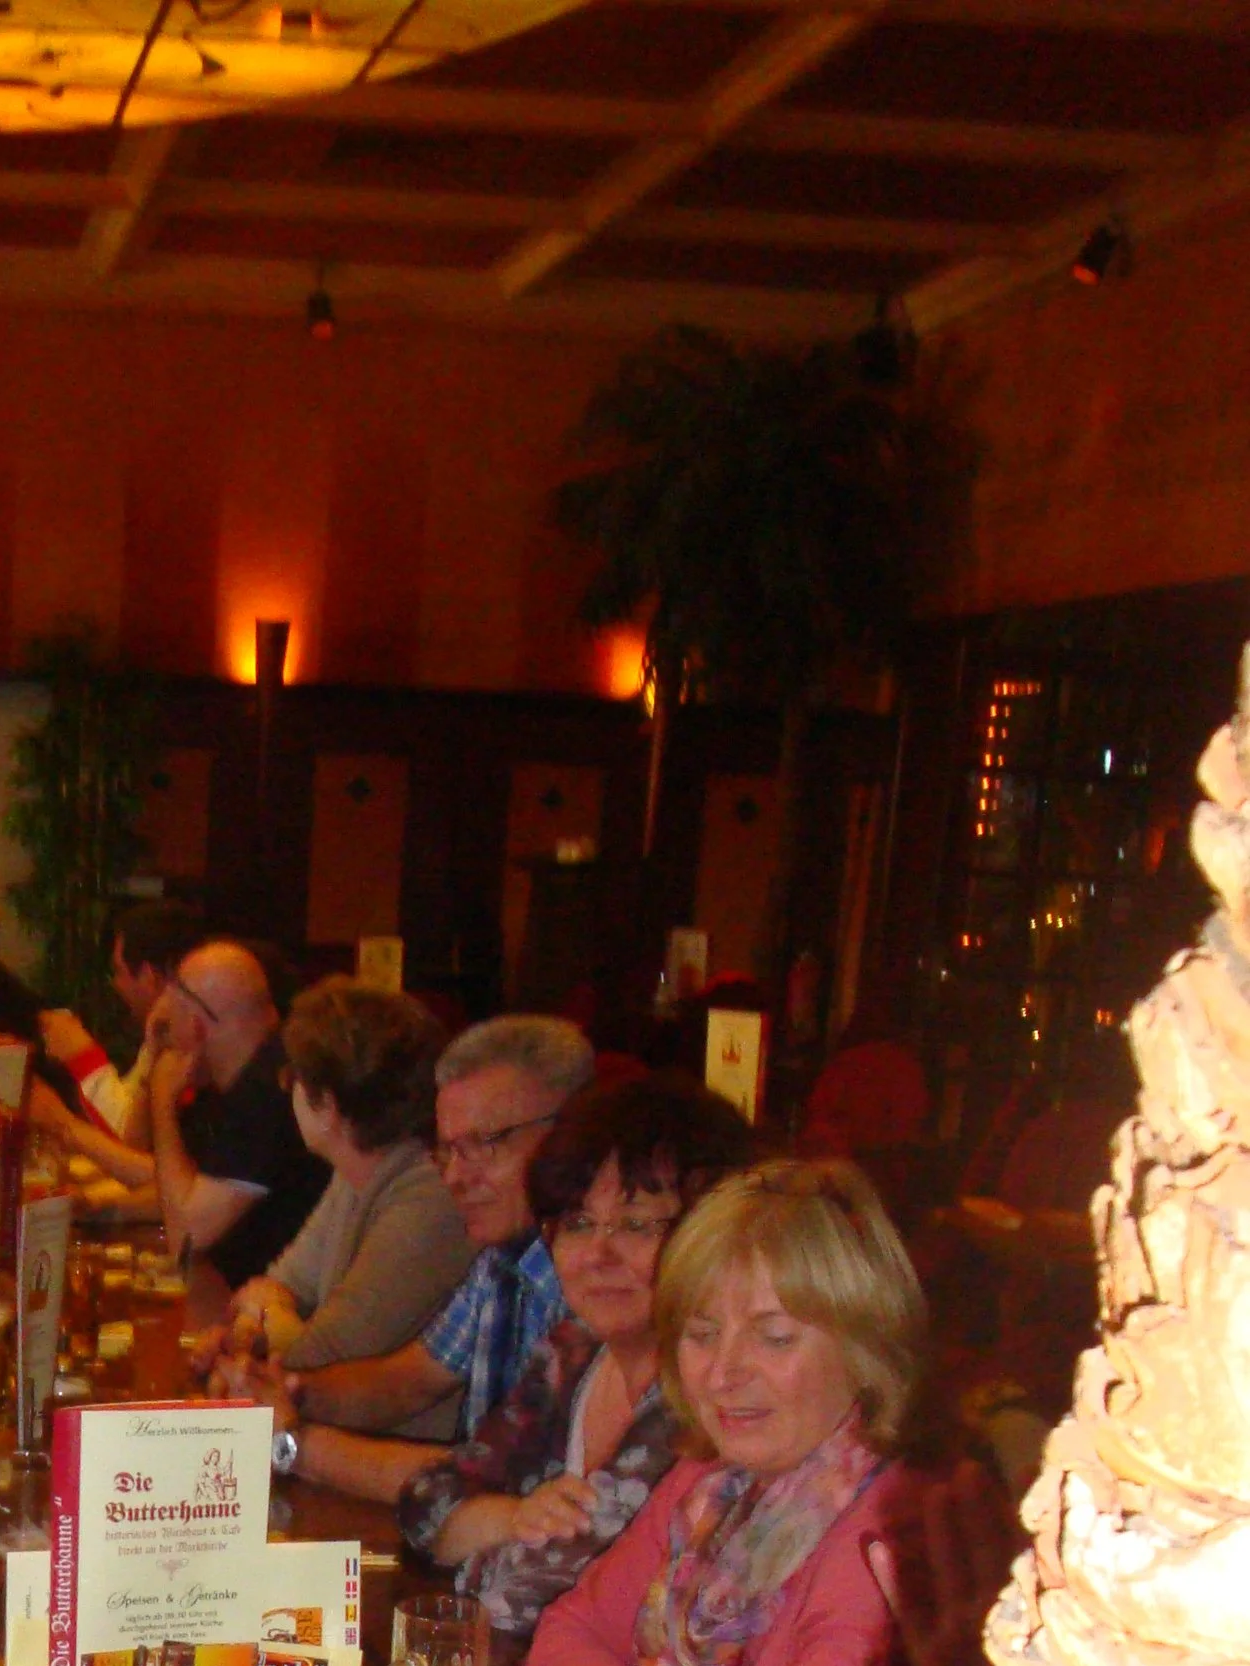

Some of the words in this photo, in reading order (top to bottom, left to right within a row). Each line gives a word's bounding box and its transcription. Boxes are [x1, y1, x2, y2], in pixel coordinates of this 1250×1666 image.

[114, 1471, 153, 1493] Die
[105, 1499, 241, 1525] Butterhanne
[51, 1514, 75, 1634] Butterhanne
[106, 1588, 159, 1610] Speisen
[166, 1593, 174, 1603] &
